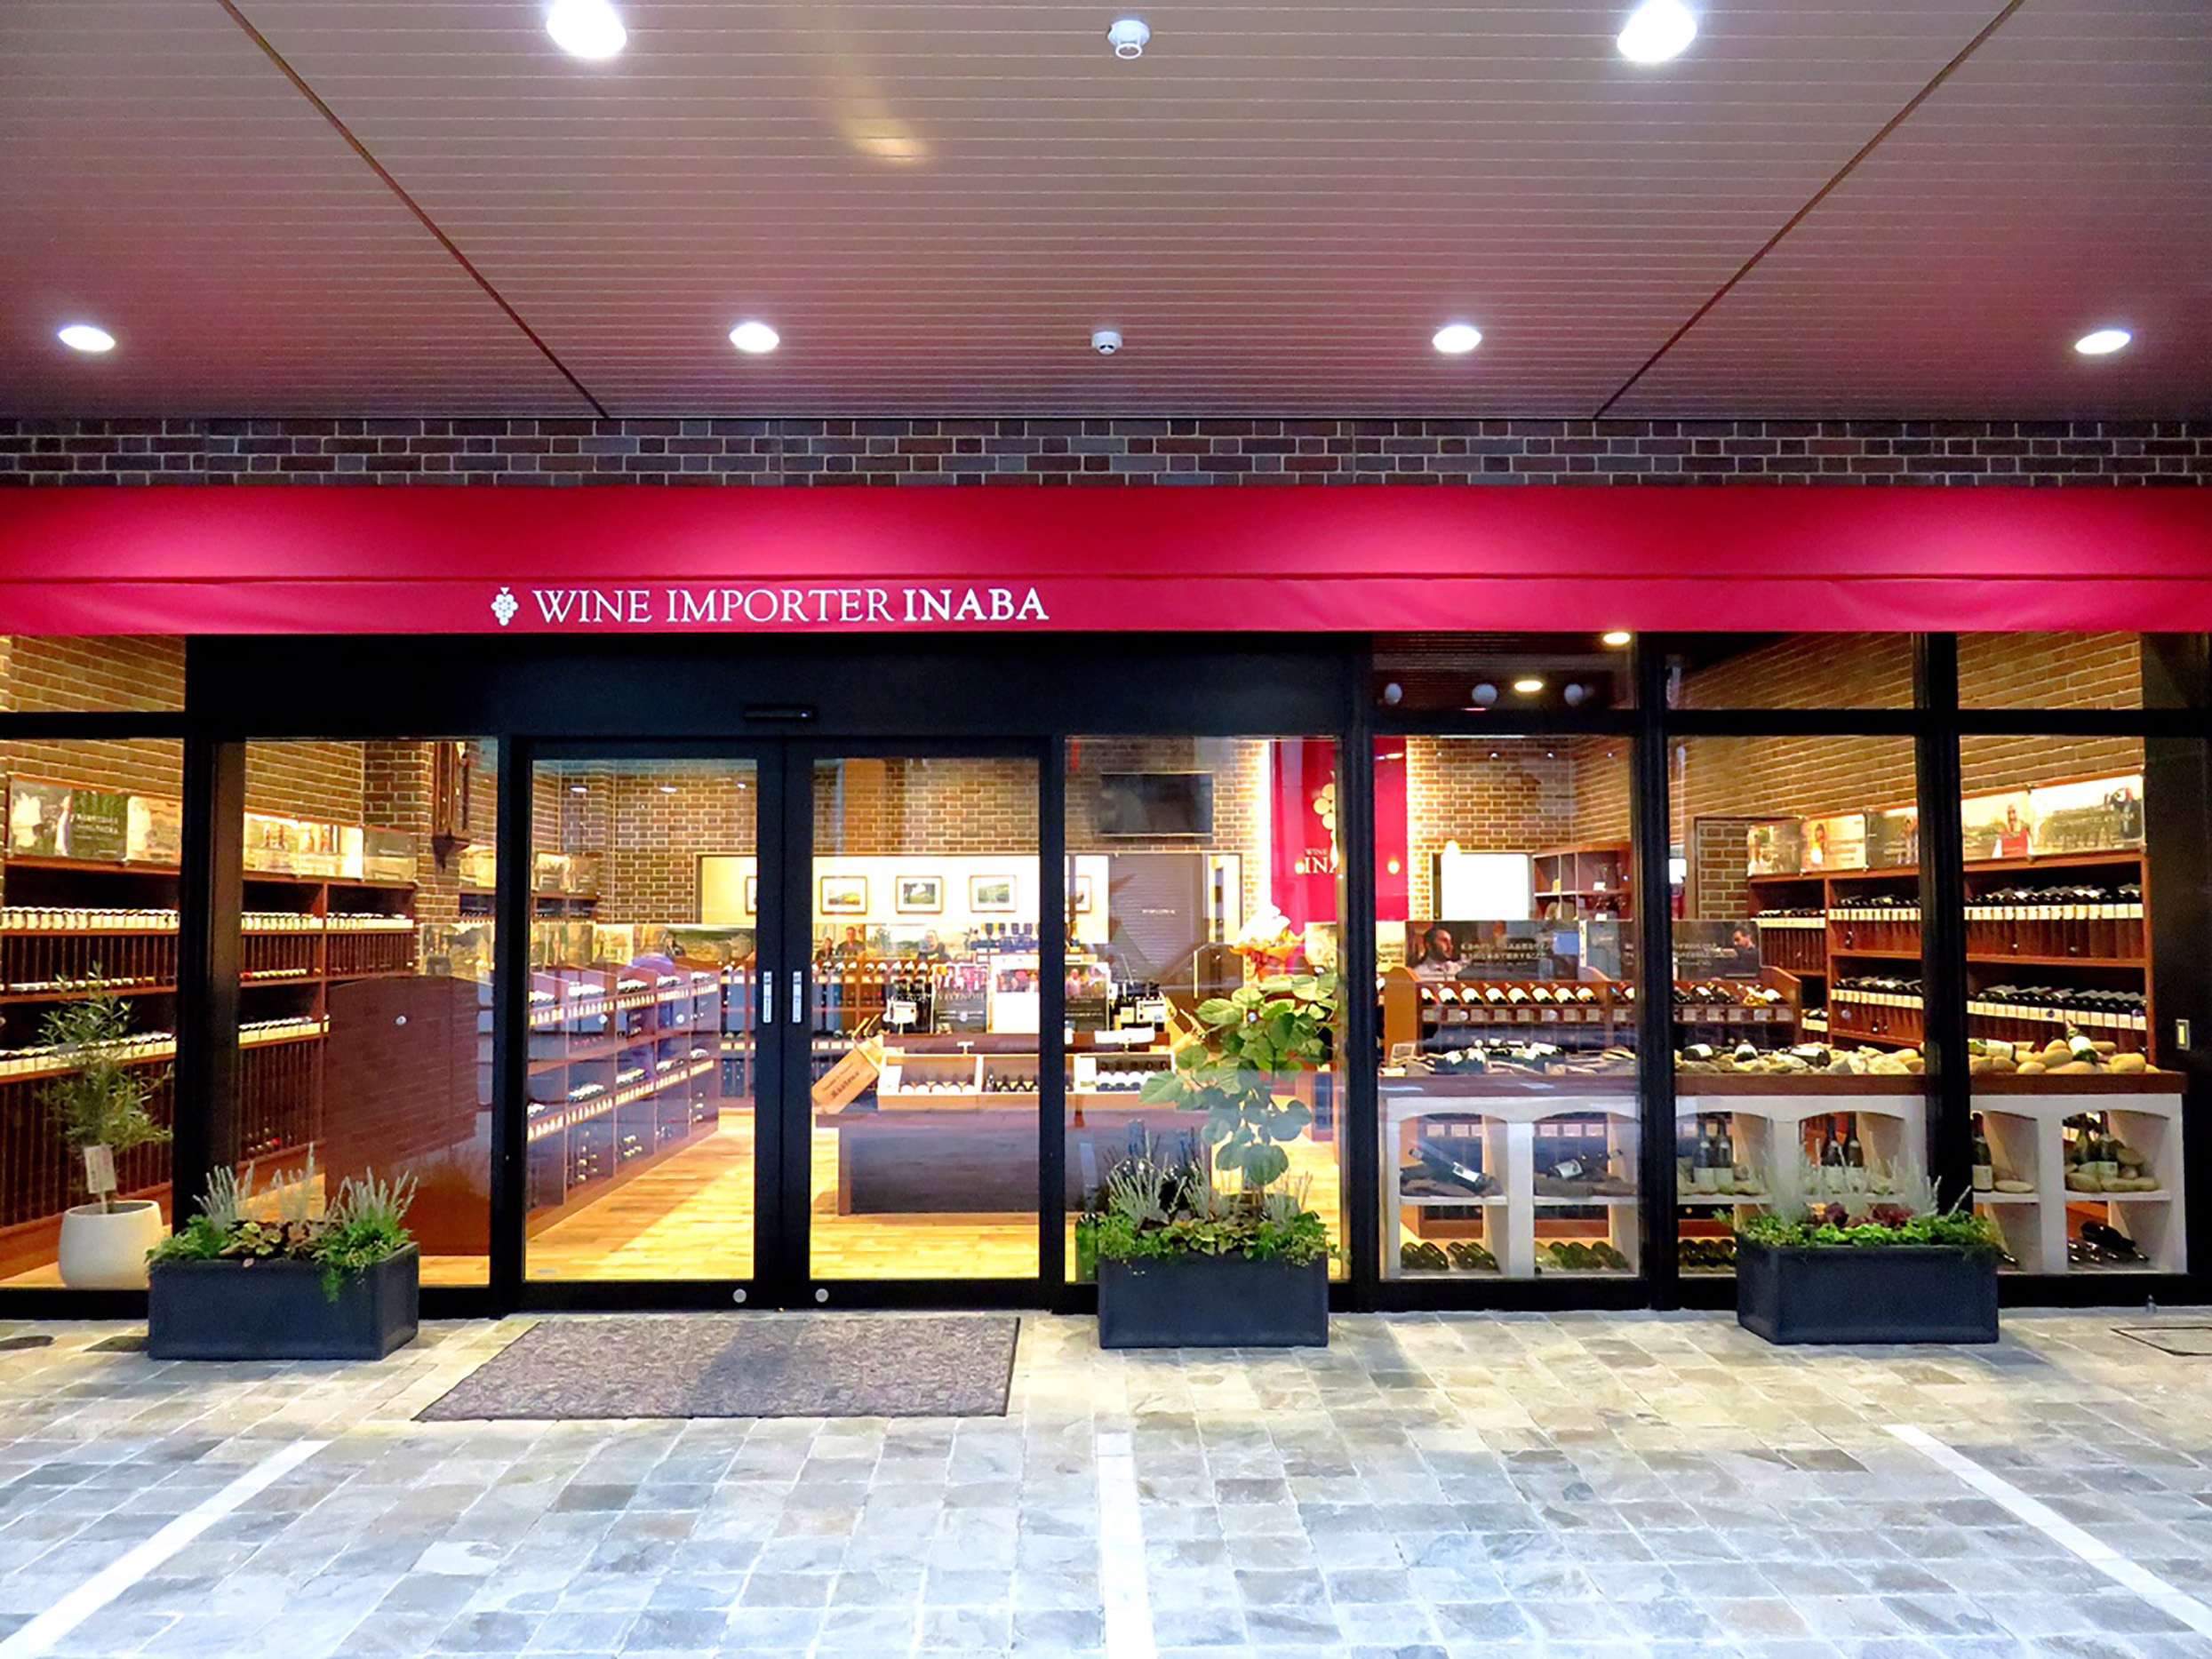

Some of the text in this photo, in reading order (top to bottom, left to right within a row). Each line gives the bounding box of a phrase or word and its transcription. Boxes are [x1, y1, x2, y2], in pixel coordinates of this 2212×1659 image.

[533, 587, 1050, 623] WINE IMPORTER INABA
